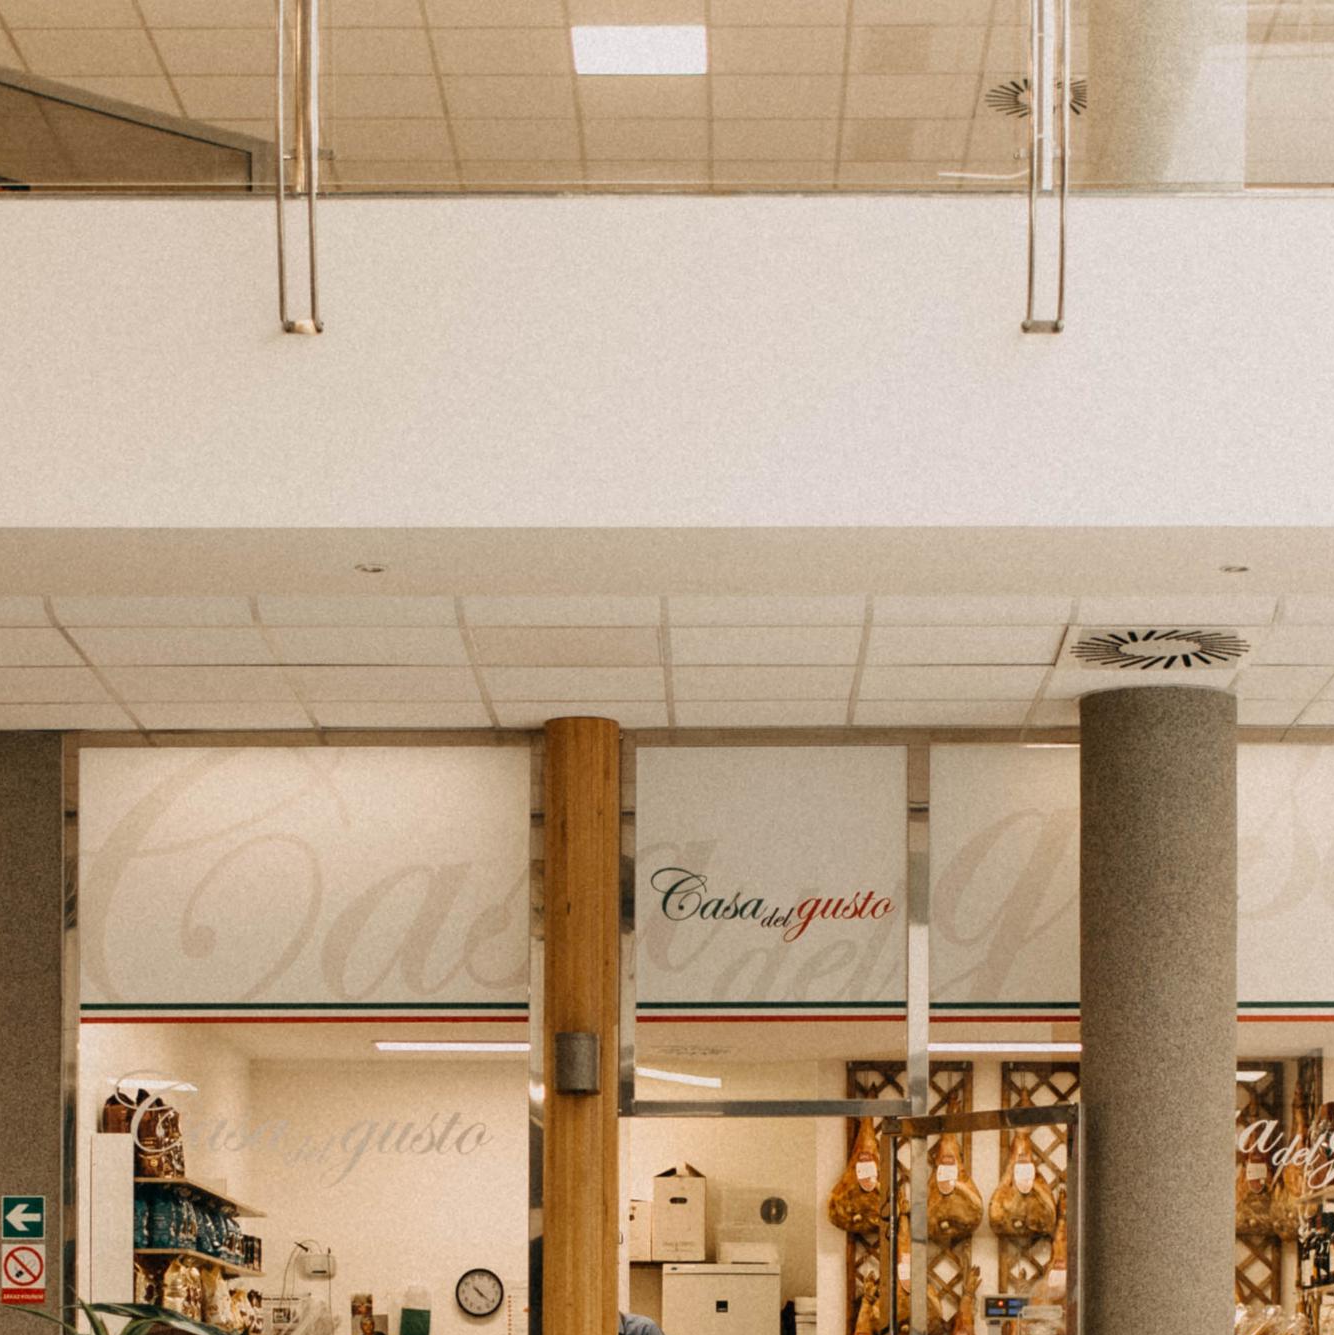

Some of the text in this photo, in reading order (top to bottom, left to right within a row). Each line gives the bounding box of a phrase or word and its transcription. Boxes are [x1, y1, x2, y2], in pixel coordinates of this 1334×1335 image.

[650, 867, 896, 942] Casa del gusto
[113, 1070, 289, 1153] Casa
[322, 1111, 494, 1189] gusto
